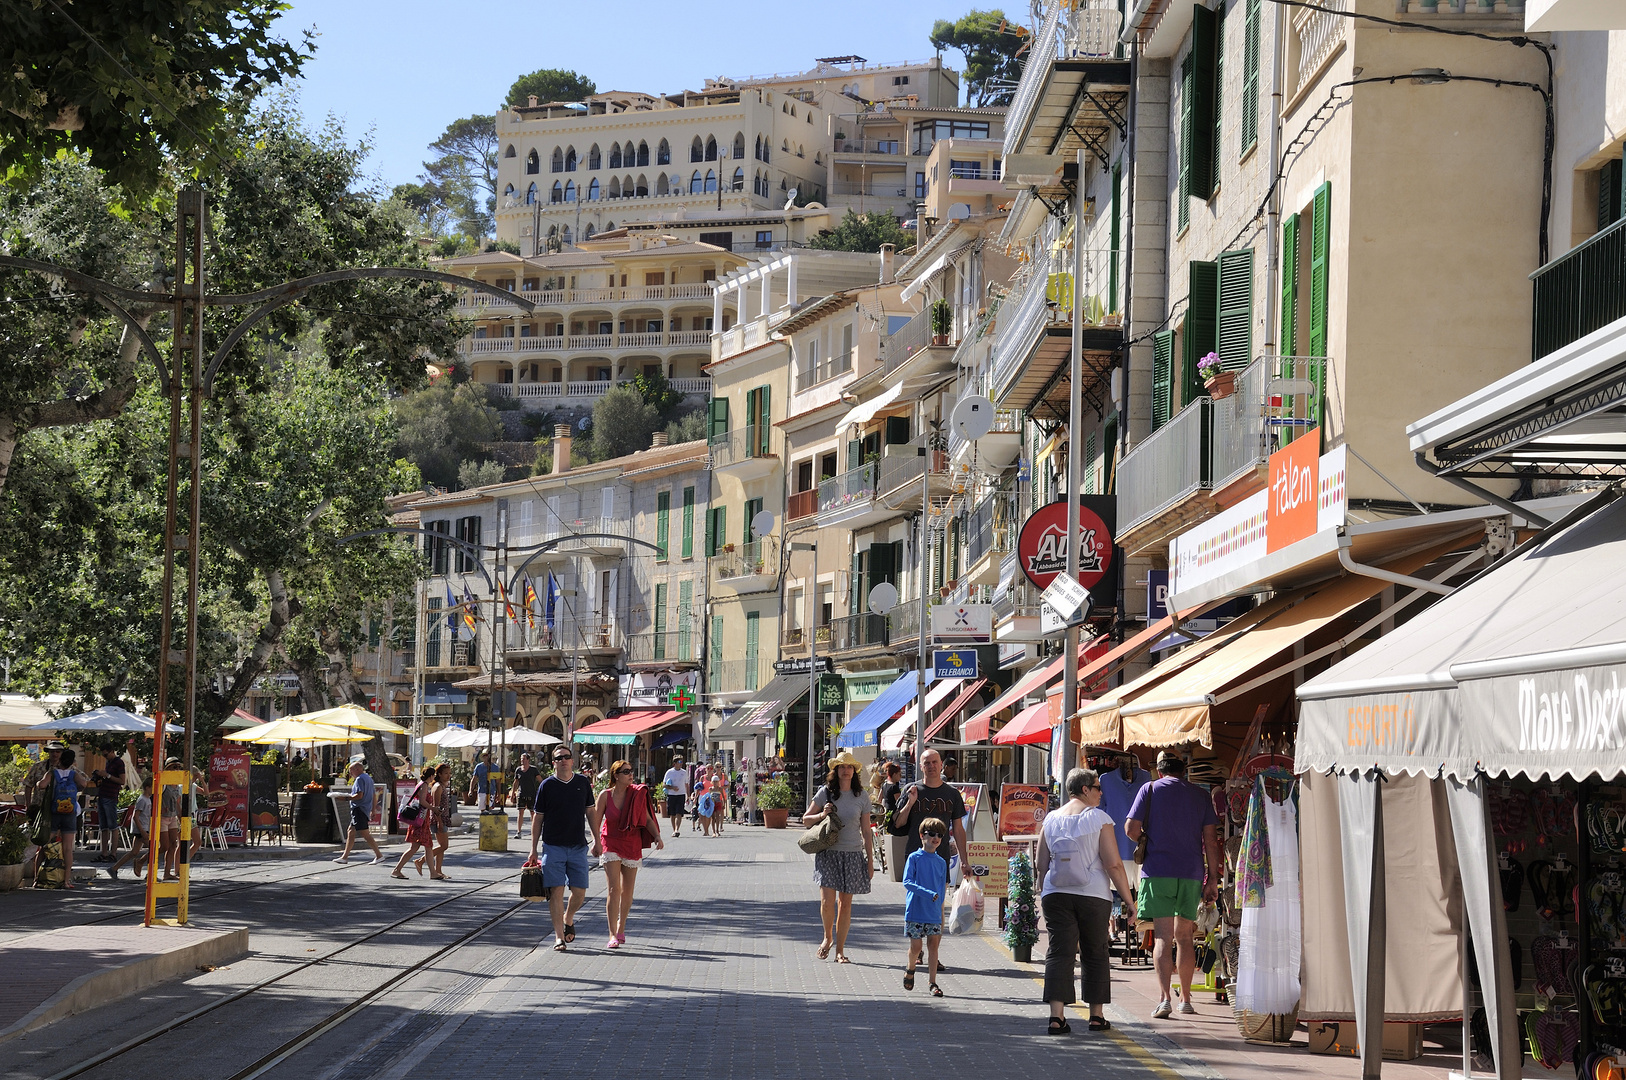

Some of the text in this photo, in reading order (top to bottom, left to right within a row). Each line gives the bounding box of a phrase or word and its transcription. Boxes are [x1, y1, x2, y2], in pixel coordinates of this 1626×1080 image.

[1273, 455, 1312, 517] tàlem
[937, 667, 974, 677] TELEBANCO
[1347, 704, 1399, 747] ESPORT
[1518, 678, 1573, 751] Mare
[227, 757, 244, 767] Style
[1013, 789, 1037, 800] Gold
